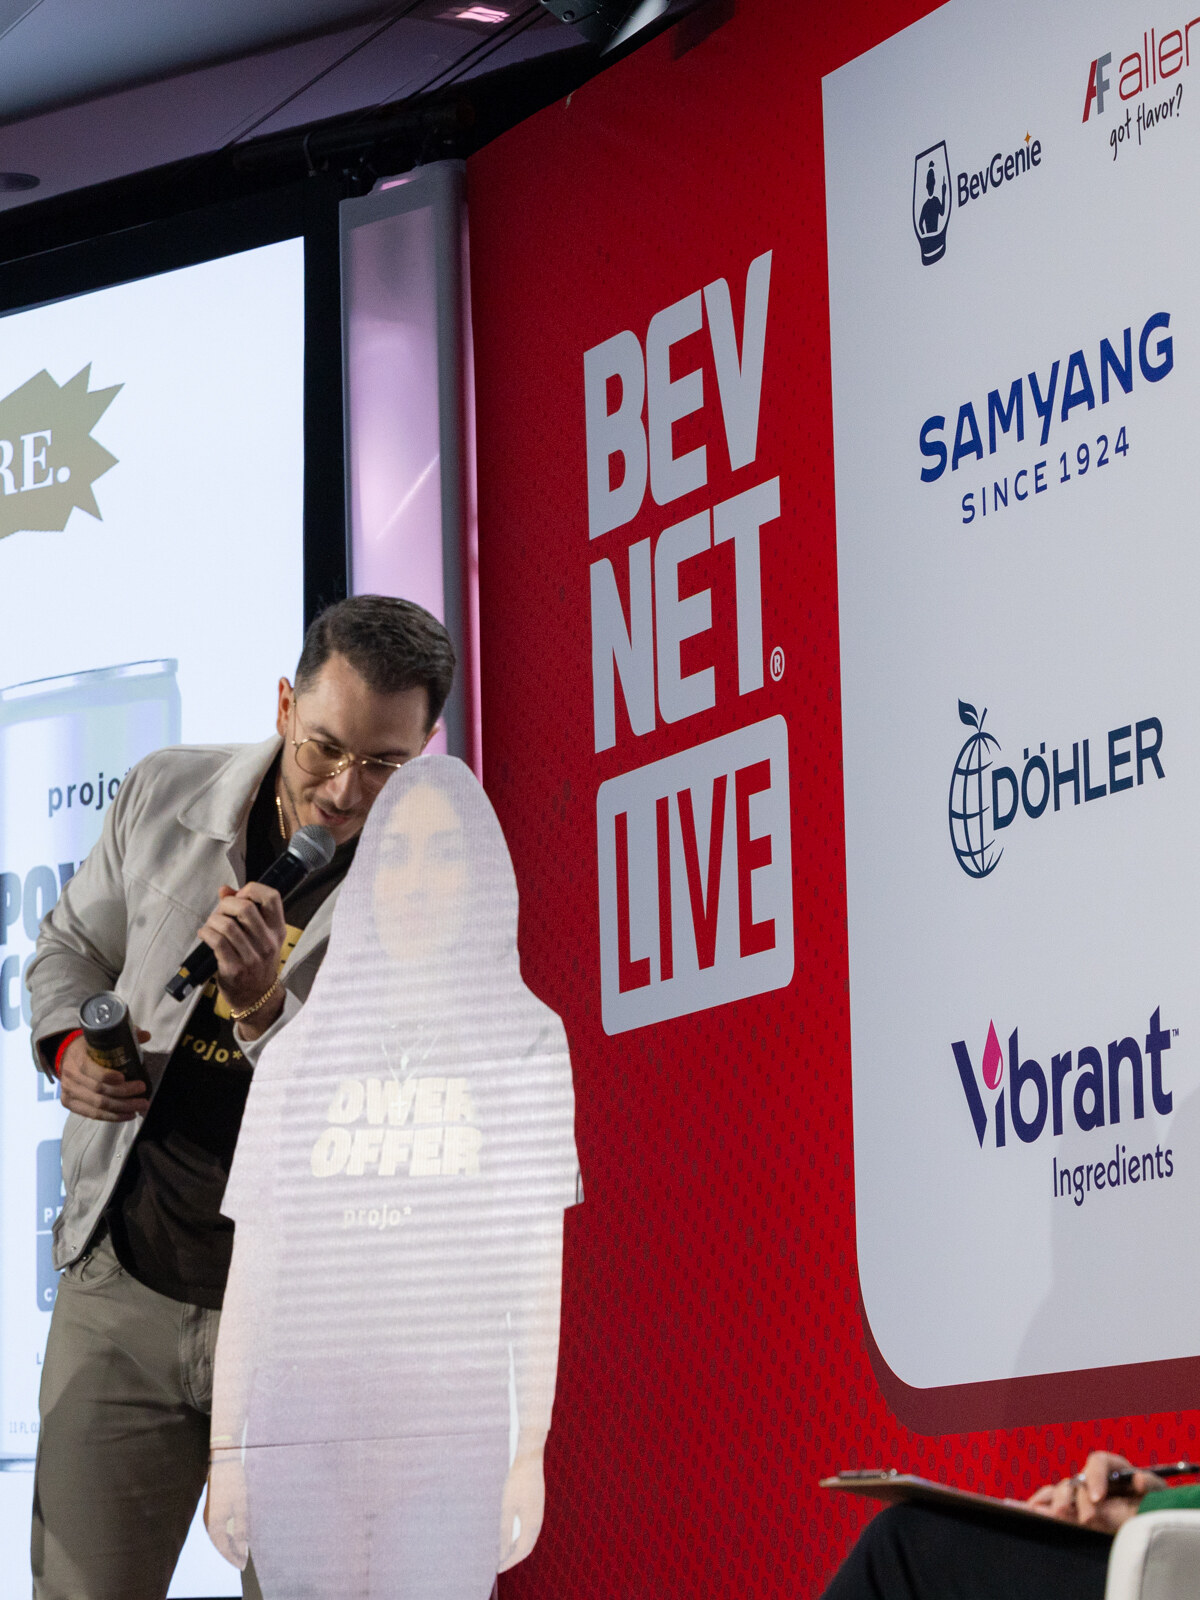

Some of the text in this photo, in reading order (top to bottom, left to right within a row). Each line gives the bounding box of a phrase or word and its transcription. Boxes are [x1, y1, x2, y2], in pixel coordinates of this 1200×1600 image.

[957, 139, 1042, 208] BevGenie
[1109, 82, 1183, 161] got flavor?
[584, 249, 773, 541] BEV
[919, 311, 1174, 483] SAMYANG
[961, 425, 1130, 524] SINCE 1924
[589, 475, 781, 754] NET
[991, 716, 1166, 831] DÖHLER
[614, 758, 776, 994] LIVE
[951, 1004, 1174, 1149] Vibrant
[1053, 1143, 1174, 1207] Ingredients
